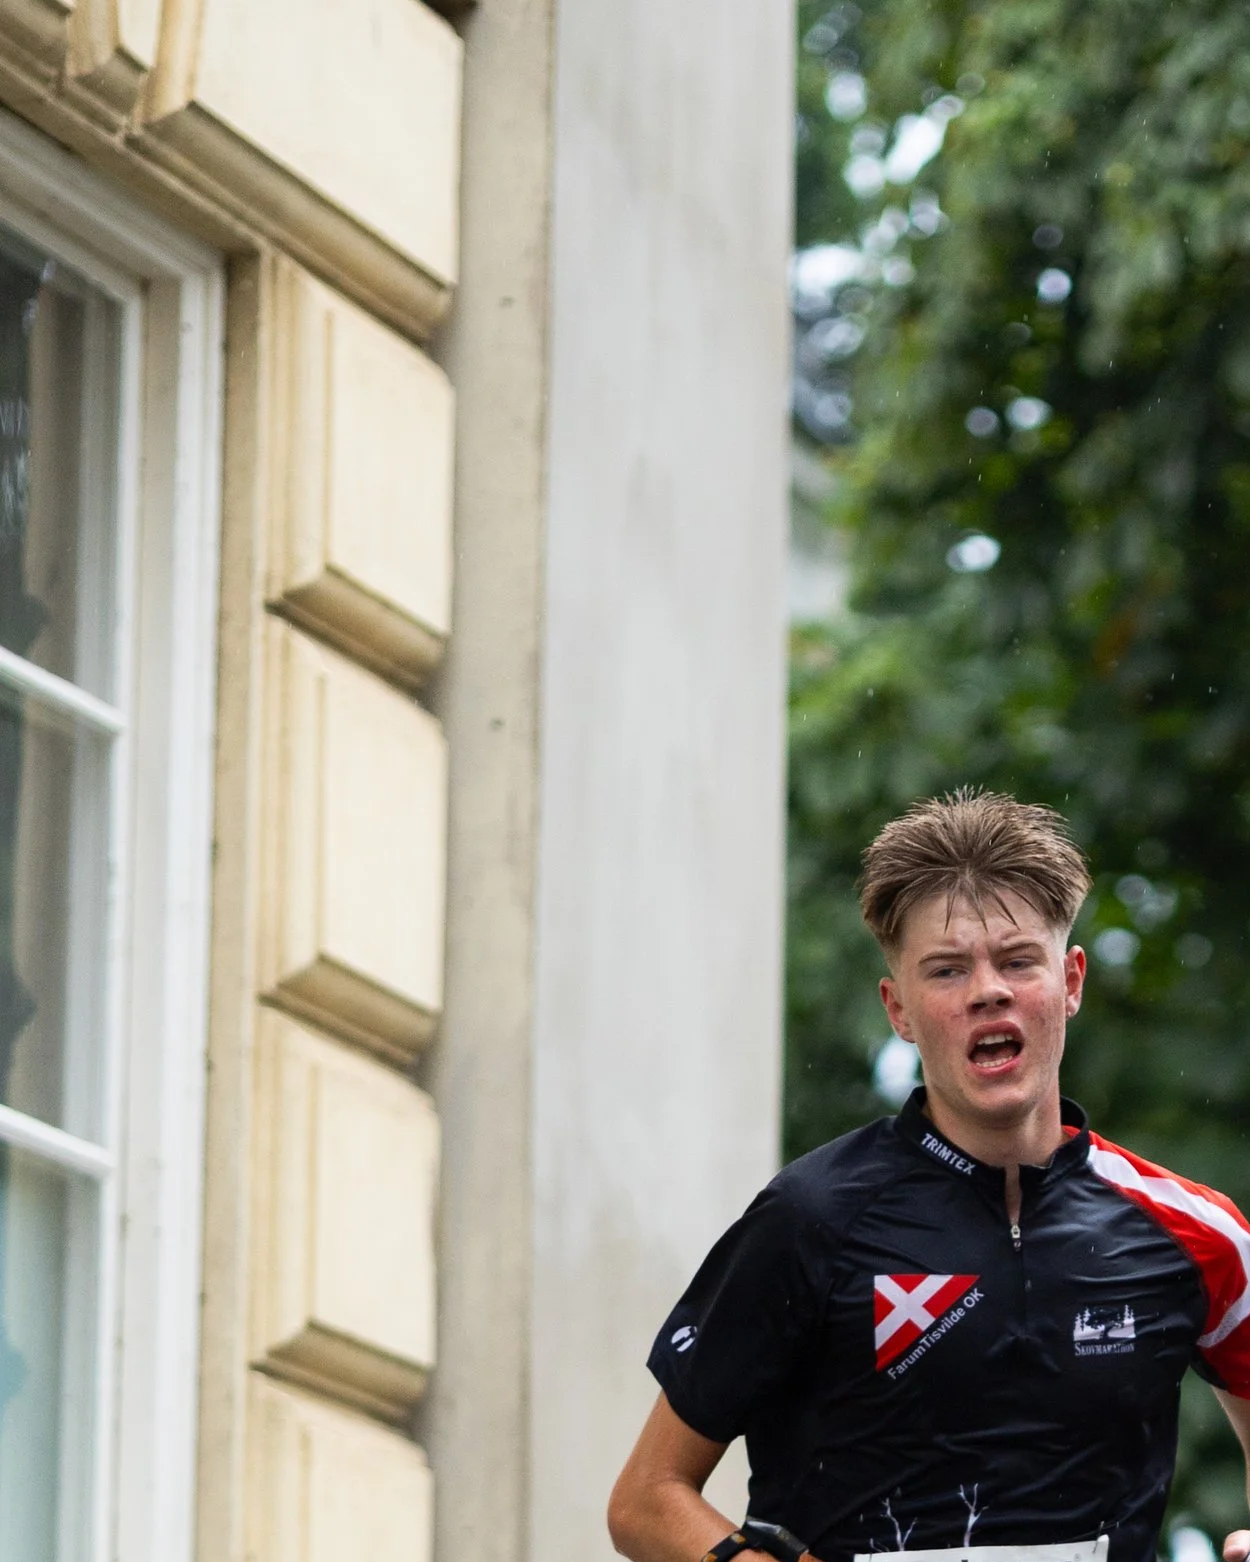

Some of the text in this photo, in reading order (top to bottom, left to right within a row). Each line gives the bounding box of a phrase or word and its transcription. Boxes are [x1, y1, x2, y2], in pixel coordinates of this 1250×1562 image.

[921, 1132, 976, 1176] TRIMTEX
[887, 1287, 985, 1380] FarumTisvilde OK
